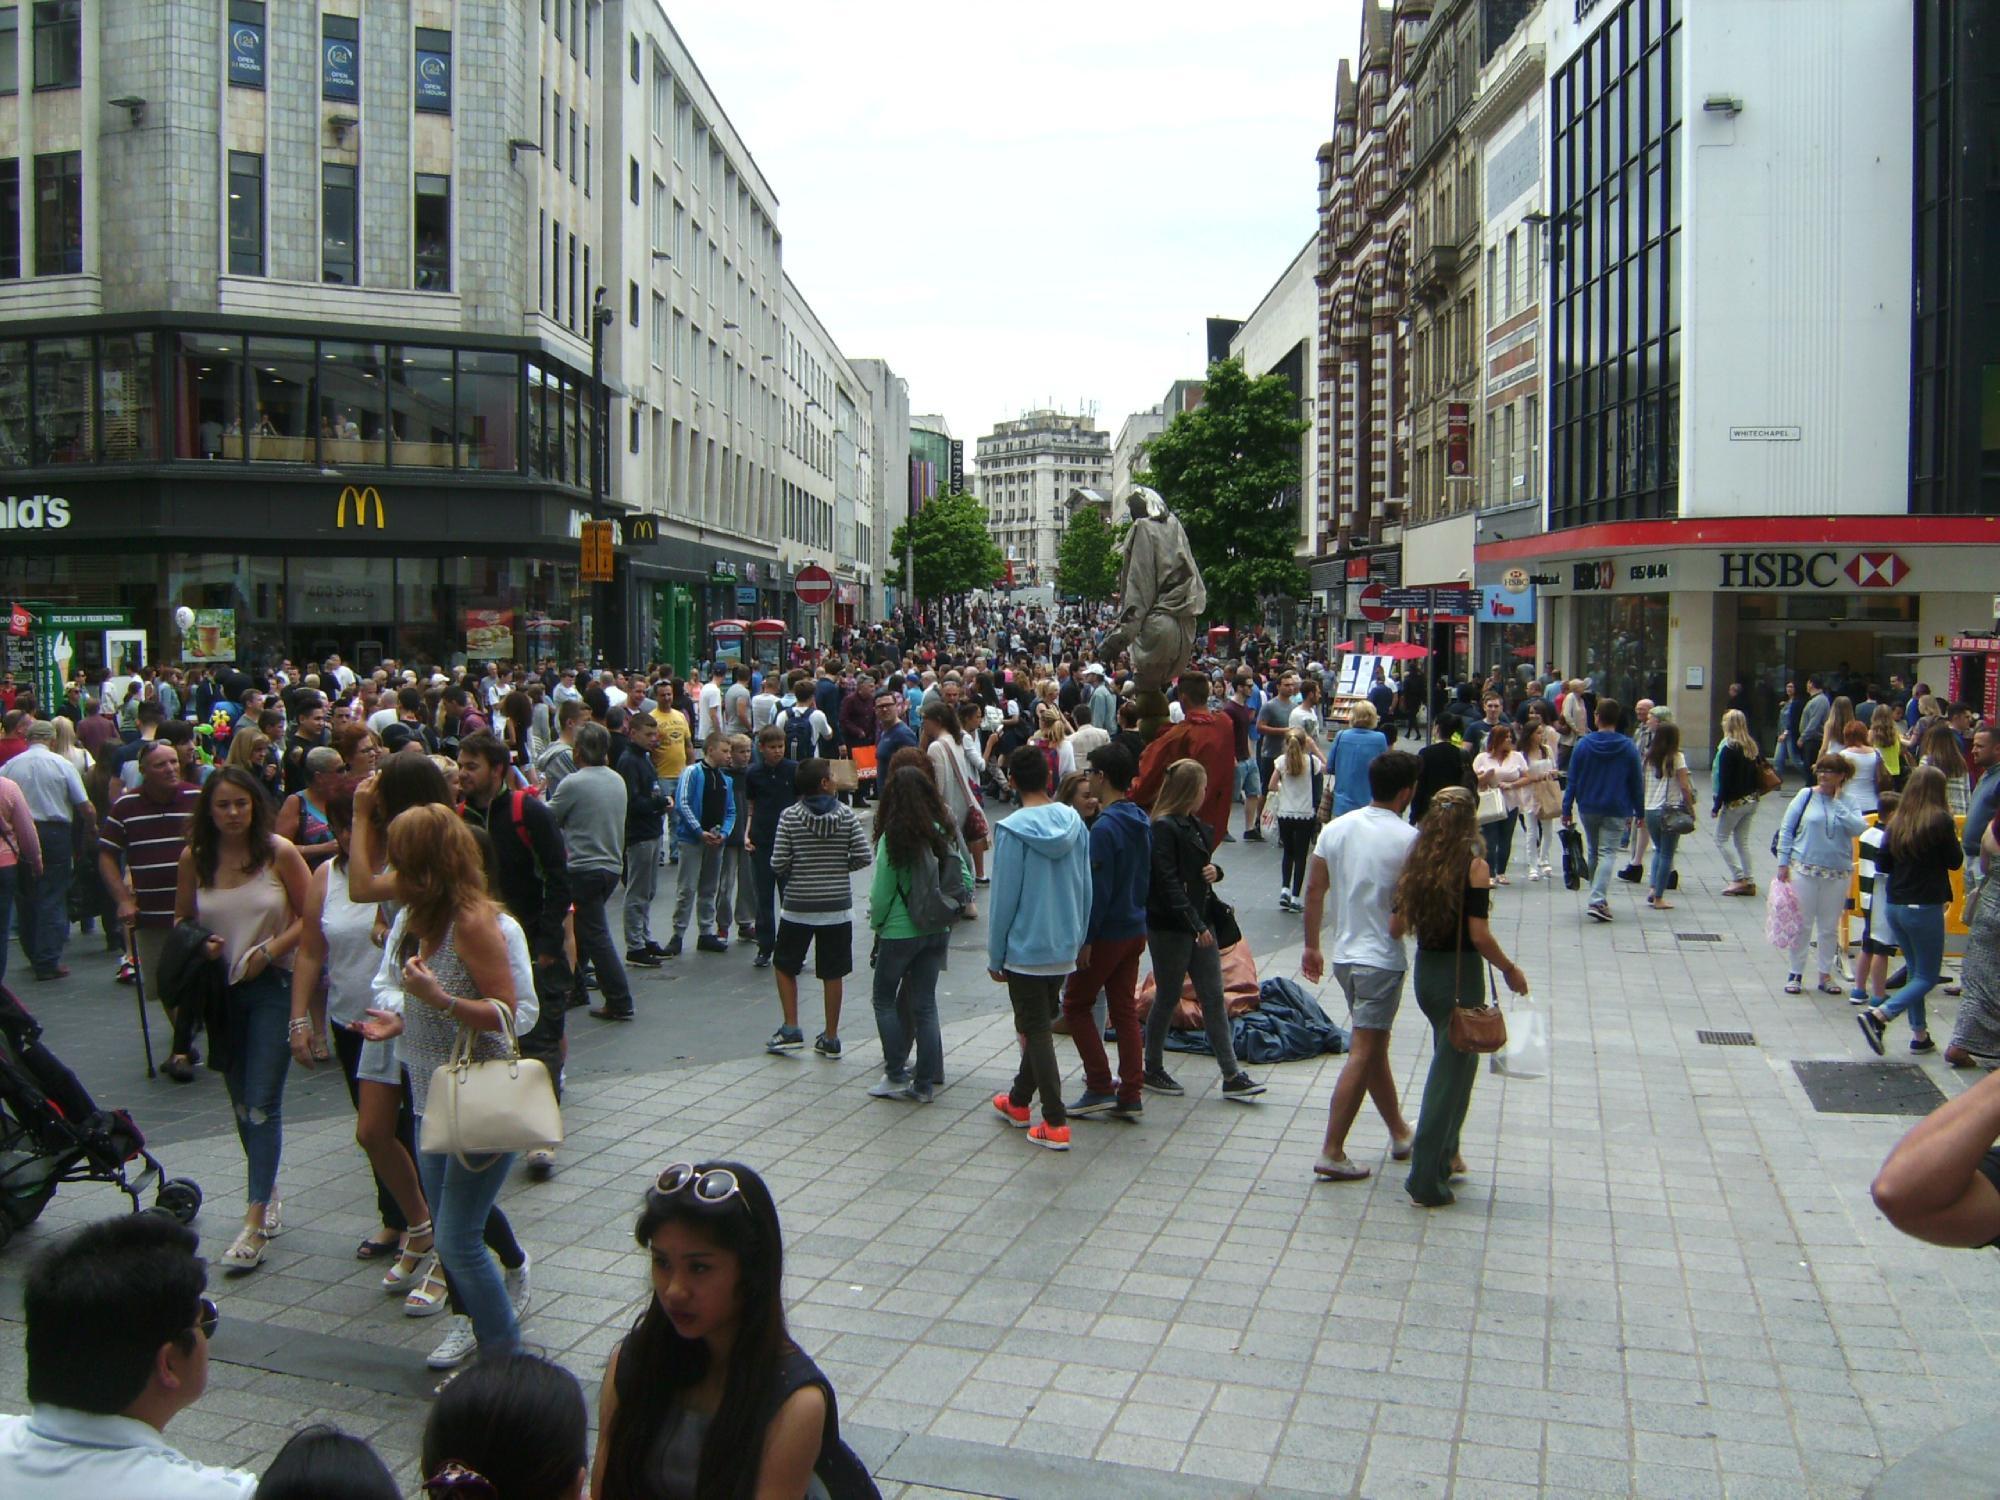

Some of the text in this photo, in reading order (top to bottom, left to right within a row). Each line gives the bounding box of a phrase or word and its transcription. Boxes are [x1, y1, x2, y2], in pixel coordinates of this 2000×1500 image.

[0, 495, 71, 528] ld's
[1504, 577, 1529, 586] HSBC
[1719, 552, 1838, 588] HSBC
